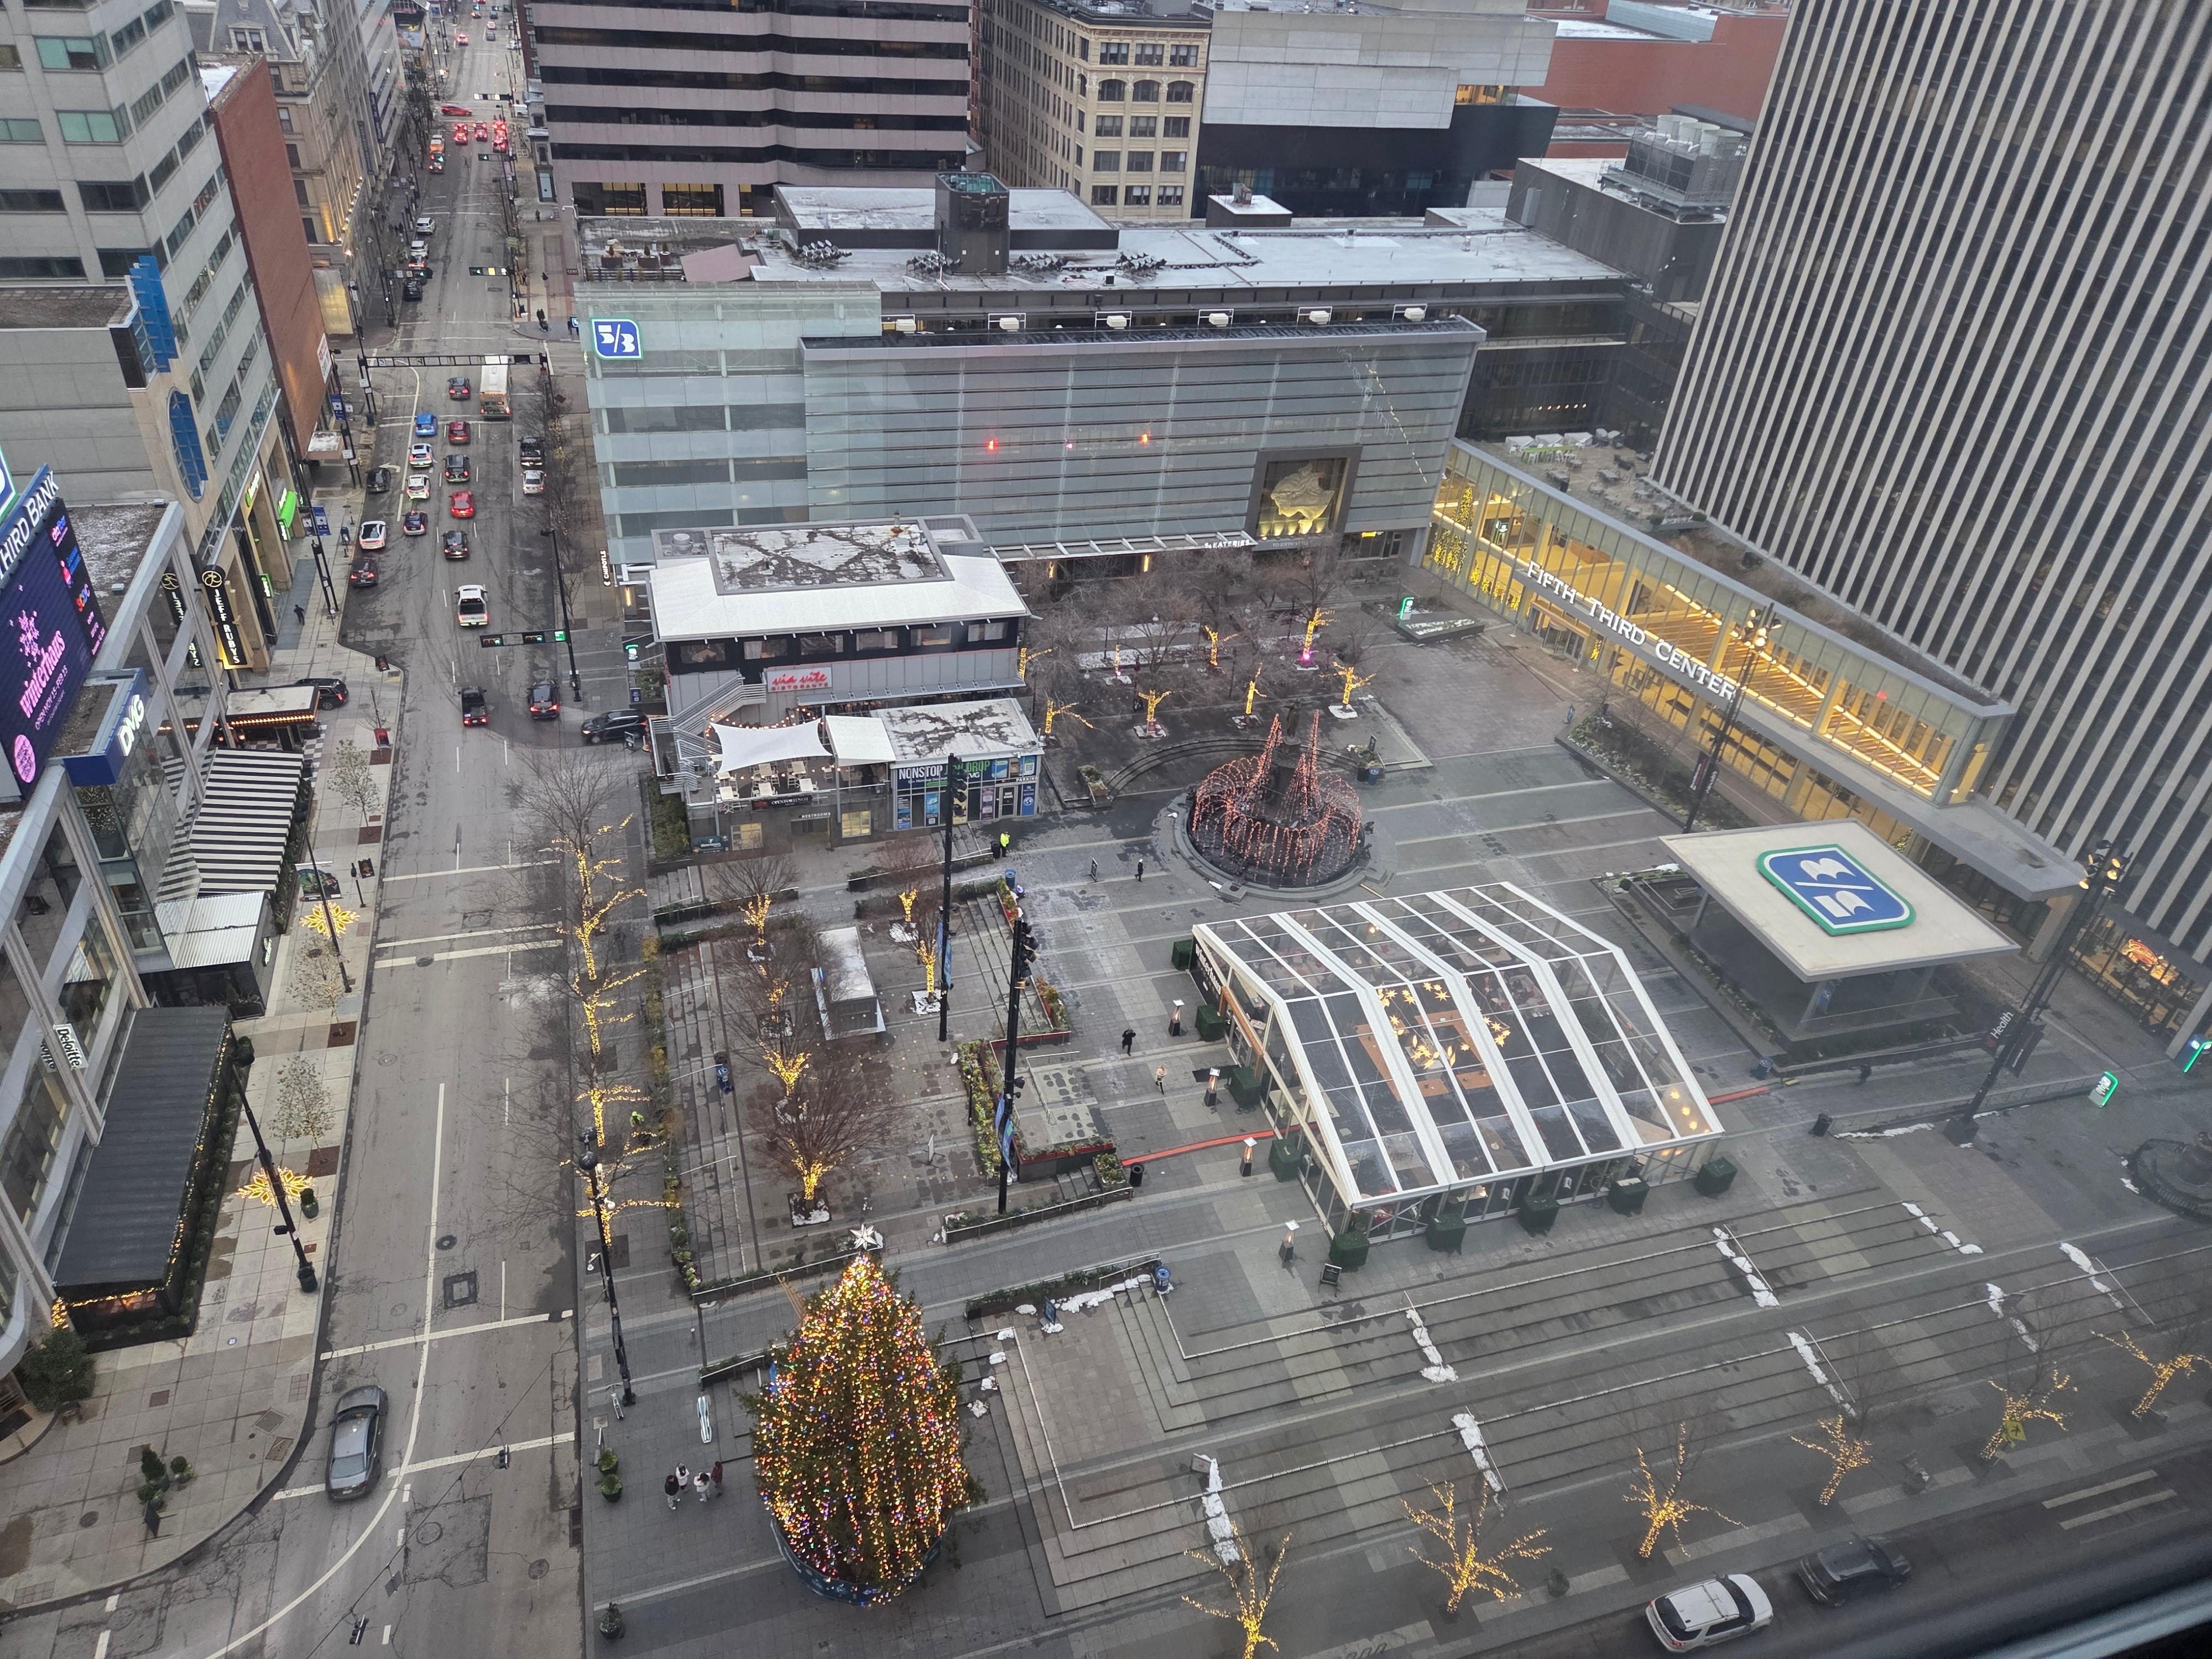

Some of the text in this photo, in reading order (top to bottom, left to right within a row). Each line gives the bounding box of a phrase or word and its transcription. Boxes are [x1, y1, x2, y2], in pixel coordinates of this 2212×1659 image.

[27, 470, 59, 528] BANK
[1213, 539, 1250, 549] EATERIES
[215, 588, 227, 622] JEFF
[1527, 560, 1738, 703] FIFTH THIRD CENTER
[19, 630, 65, 718] winterhaus
[771, 682, 828, 691] RISTORANTE
[772, 671, 828, 686] via vite
[118, 694, 144, 757] DMG
[899, 765, 943, 780] NONSTOP
[966, 760, 990, 773] DROP
[1991, 1011, 2013, 1039] Health
